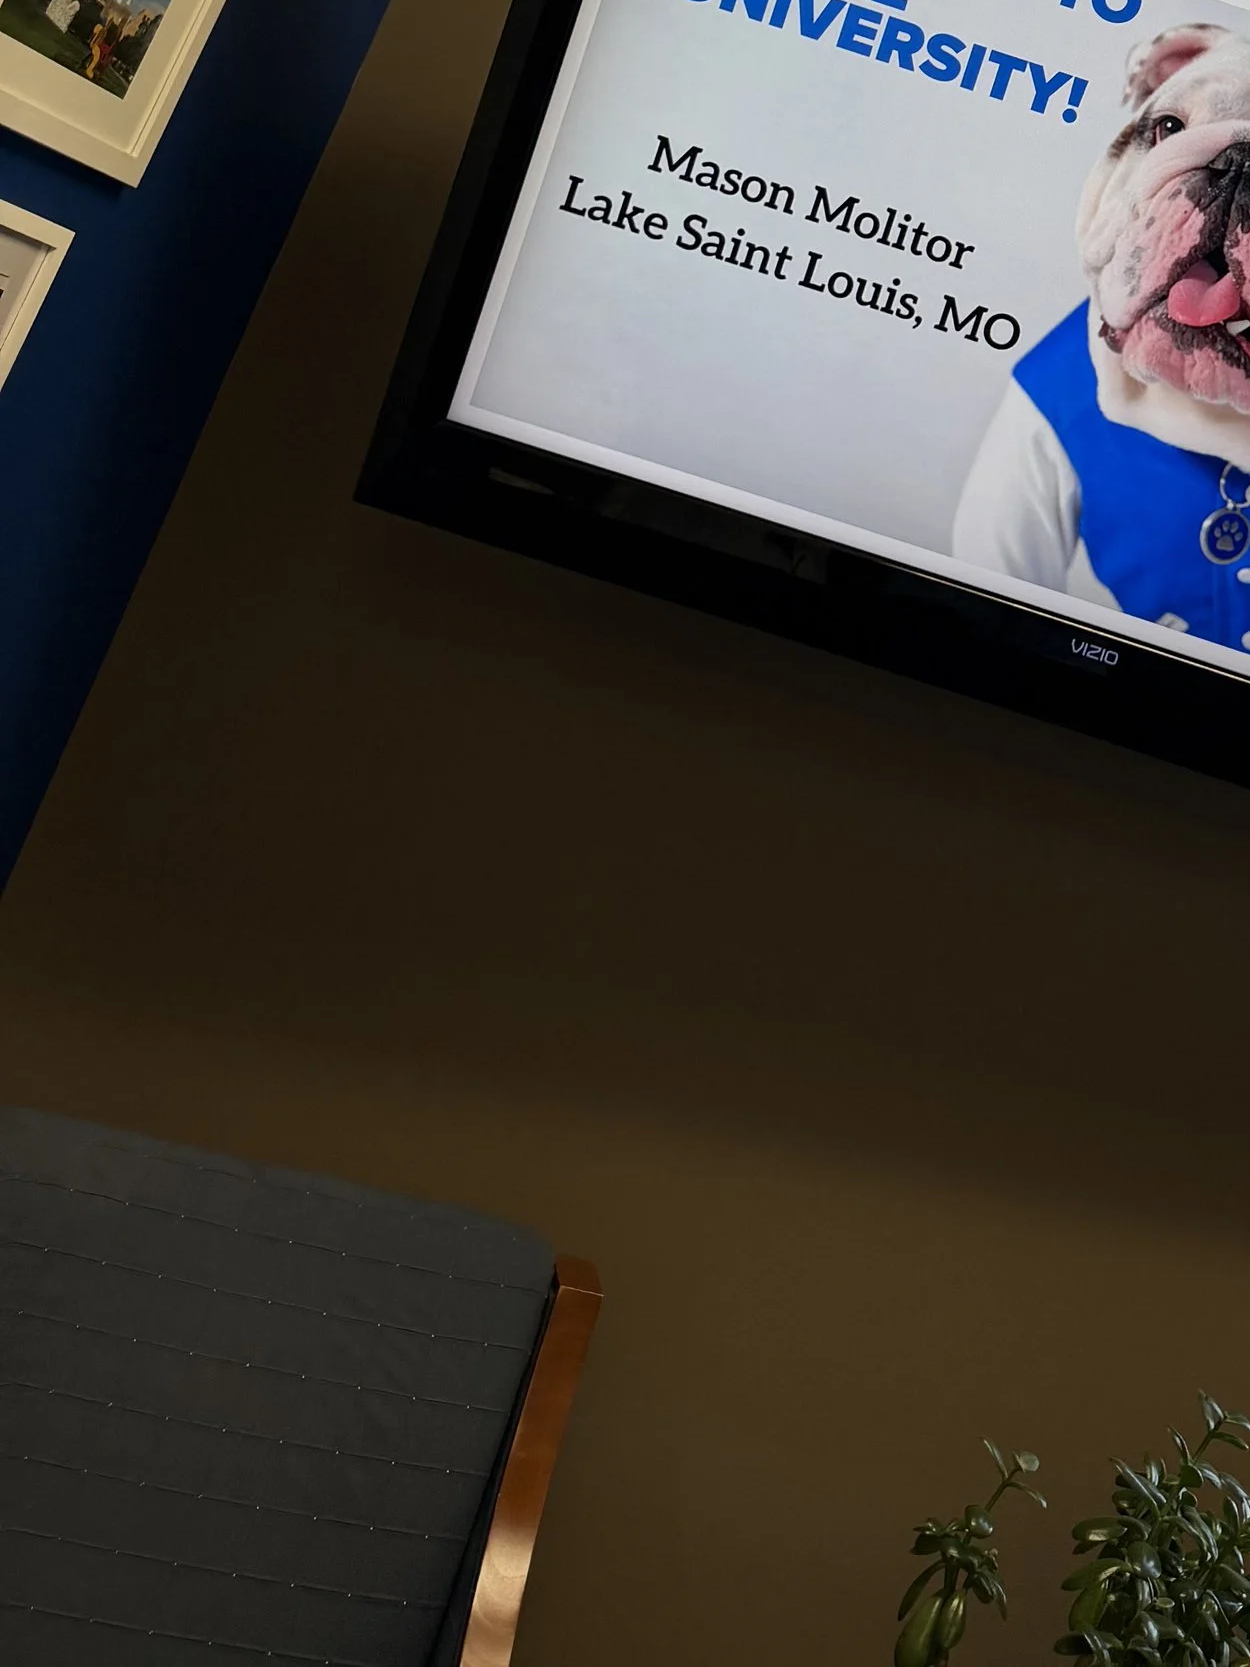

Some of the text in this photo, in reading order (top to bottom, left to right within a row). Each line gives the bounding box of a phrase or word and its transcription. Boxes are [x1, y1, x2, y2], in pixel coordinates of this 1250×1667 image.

[559, 175, 1021, 350] Lake Saint Louis, MO
[647, 135, 975, 270] Mason Molitor
[1071, 638, 1119, 666] VIZIO
